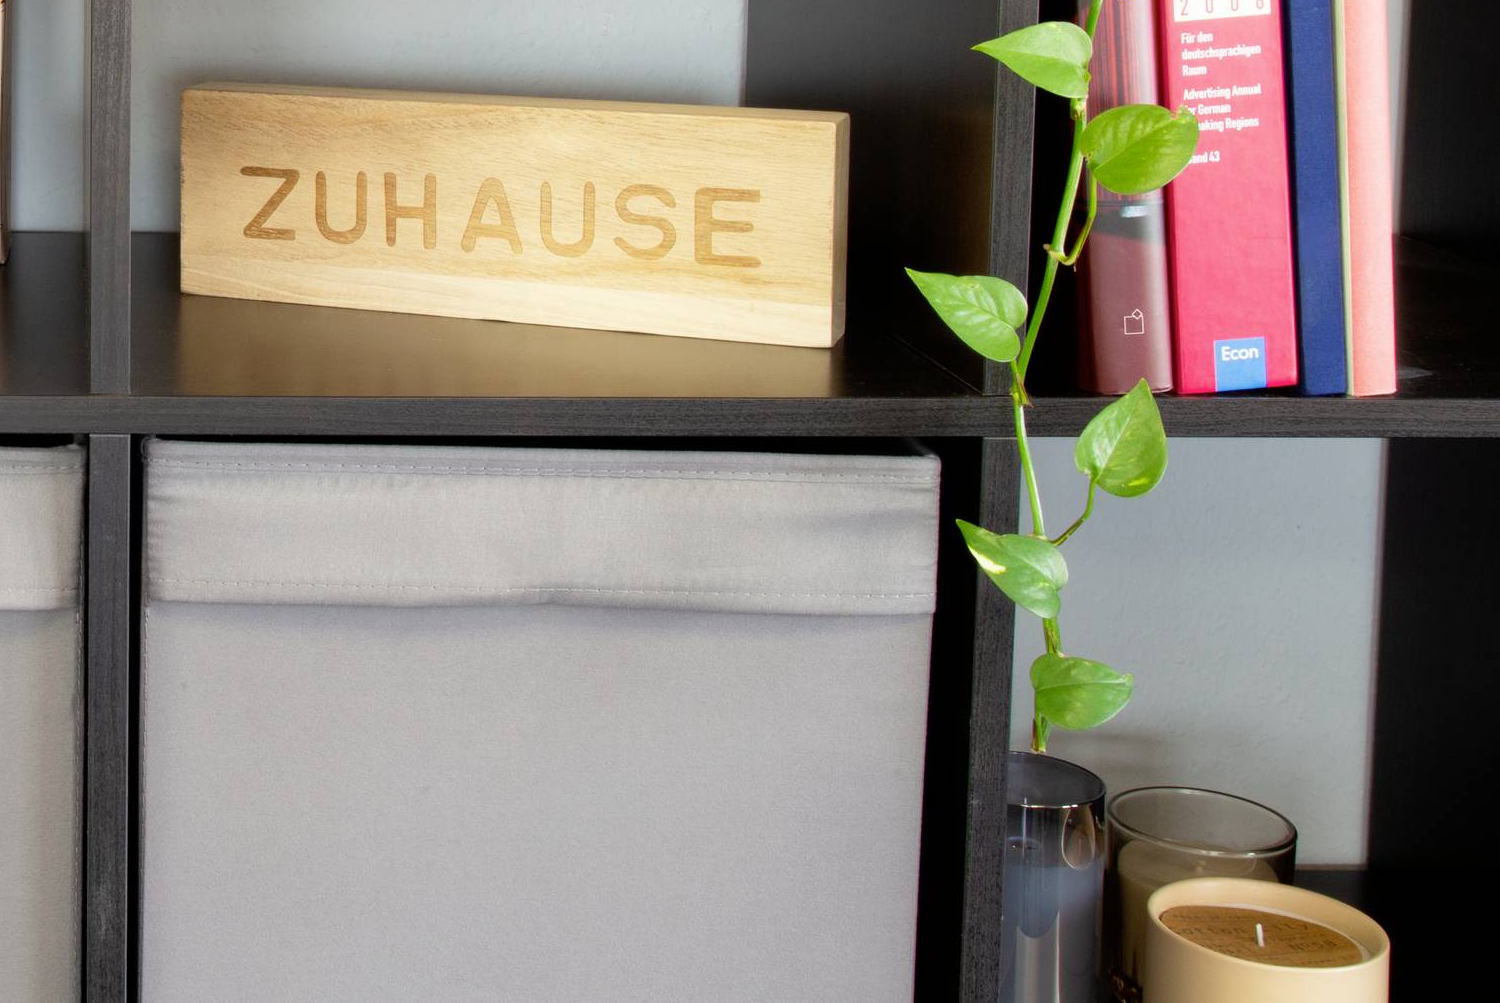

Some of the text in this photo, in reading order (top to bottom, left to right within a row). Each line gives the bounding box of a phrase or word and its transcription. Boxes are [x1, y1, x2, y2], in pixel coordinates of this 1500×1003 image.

[1181, 31, 1213, 44] Für den
[1181, 44, 1261, 60] deutschsprachigen
[1182, 65, 1207, 76] Raum
[1183, 84, 1262, 100] Advertising Annual
[1198, 103, 1231, 115] German
[1198, 117, 1260, 132] aking Regions
[1189, 150, 1220, 164] and 43
[239, 165, 762, 268] ZUHAUSE
[1221, 344, 1259, 362] Econ
